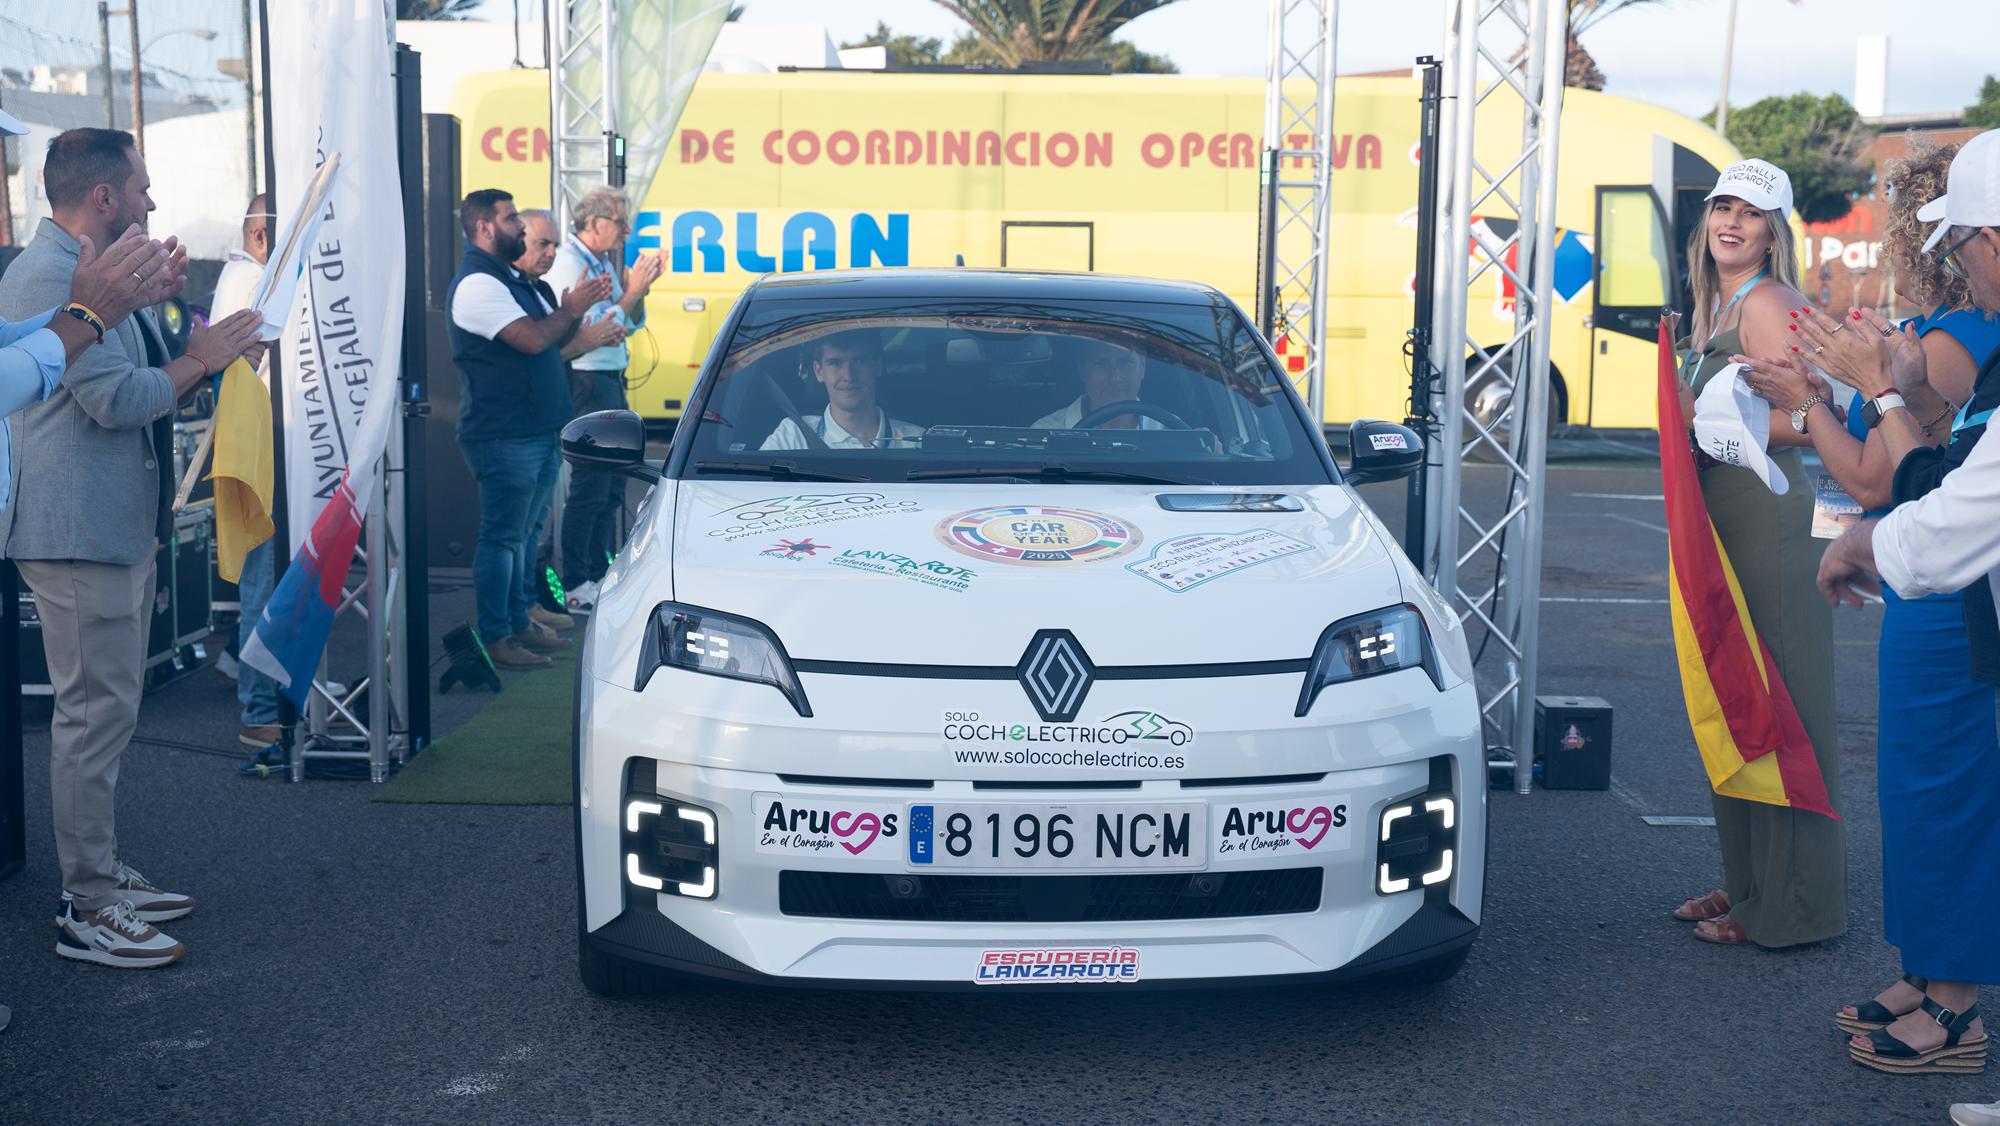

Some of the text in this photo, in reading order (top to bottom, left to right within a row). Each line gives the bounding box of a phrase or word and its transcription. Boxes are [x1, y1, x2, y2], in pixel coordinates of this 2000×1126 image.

[481, 127, 551, 162] CEN
[681, 129, 734, 164] DE
[763, 129, 1112, 168] COORDINACION
[624, 211, 909, 274] ERLAN
[1820, 236, 1885, 269] Par
[1011, 522, 1066, 532] CAR
[1015, 536, 1070, 544] YEAR
[842, 549, 978, 582] LANZAROTE
[1027, 551, 1065, 560] 2025
[896, 567, 969, 589] Restaurante
[944, 712, 979, 722] SOLO
[955, 748, 1185, 769] www.solocochelectrico.es
[764, 801, 898, 855] Arucas
[946, 813, 1190, 858] 8196 NCM
[1222, 804, 1347, 849] Arucas
[760, 833, 835, 851] En el Corazón
[917, 841, 925, 854] E
[1219, 834, 1291, 853] En el Corazón
[984, 950, 1137, 965] ESCUDERÍA
[979, 964, 1136, 978] LANZAROTE
